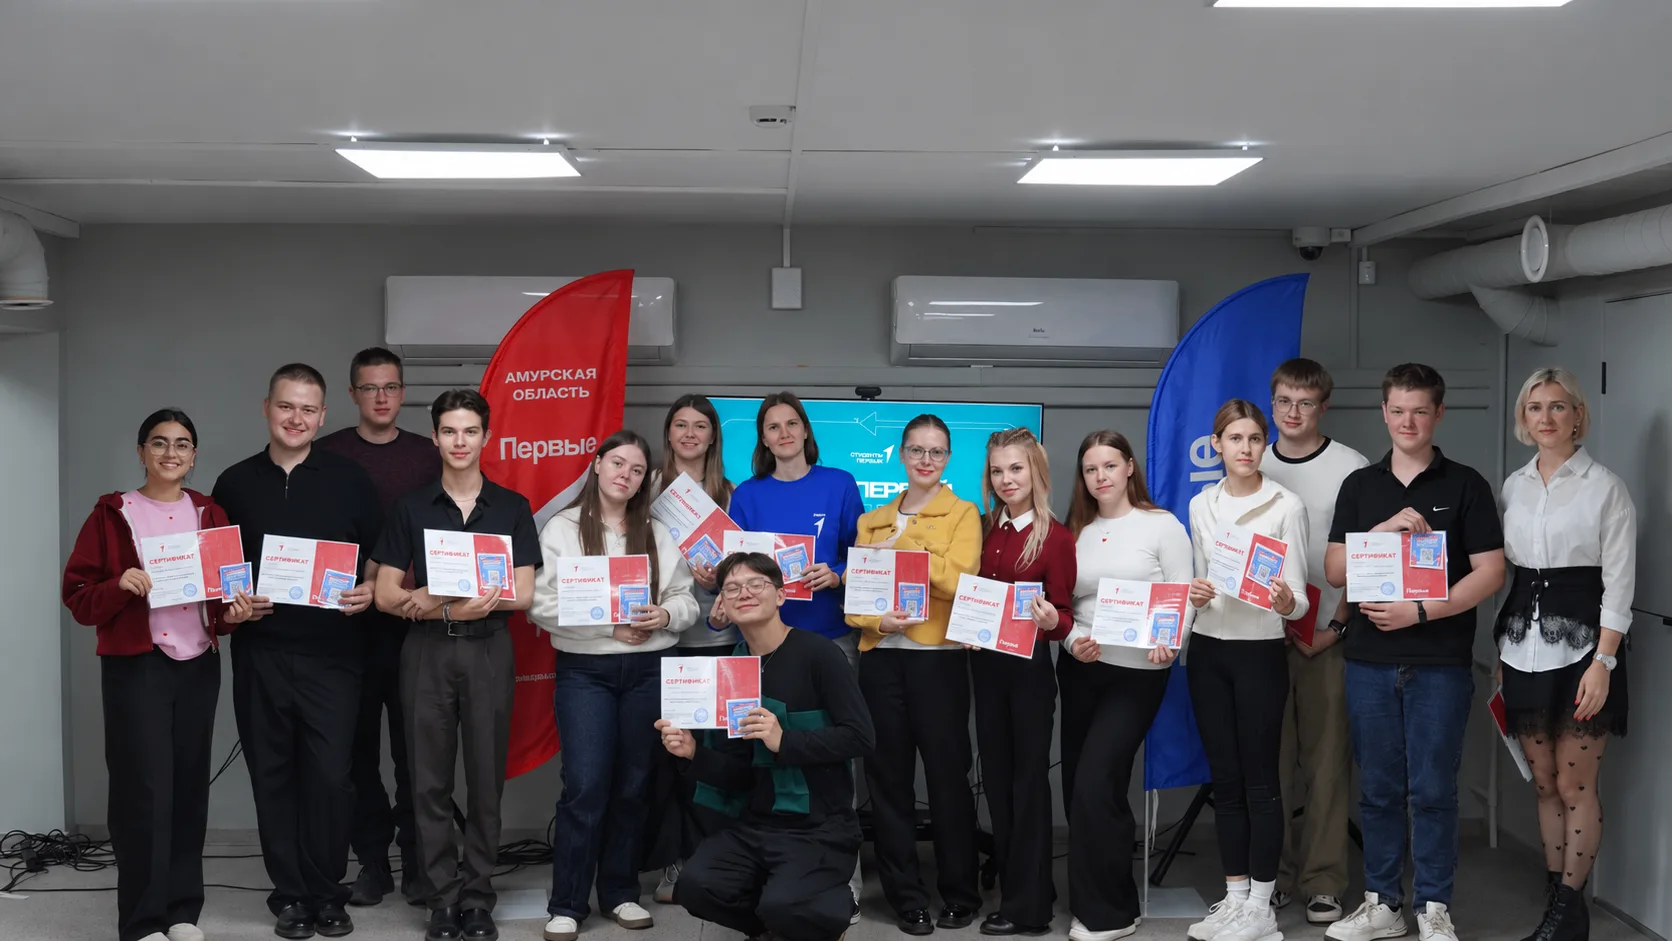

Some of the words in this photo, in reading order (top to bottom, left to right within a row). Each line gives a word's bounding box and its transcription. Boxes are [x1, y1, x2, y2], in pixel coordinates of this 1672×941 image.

[505, 368, 597, 384] АМУРСКАЯ
[513, 387, 590, 401] ОБЛАСТЬ
[500, 437, 597, 465] Первые
[429, 549, 470, 558] СЕРТИФИКАТ
[1350, 552, 1397, 560] СЕРТИФИКАТ
[149, 553, 195, 565] СЕРТИФИКАТ
[265, 555, 310, 565] СЕРТИФИКАТ
[850, 568, 892, 576] СЕРТИФИКАТ
[561, 576, 605, 584] СЕРТИФИКАТ
[958, 594, 1000, 608] СЕРТИФИКАТ
[1100, 597, 1145, 607] СЕРТИФИКАТ
